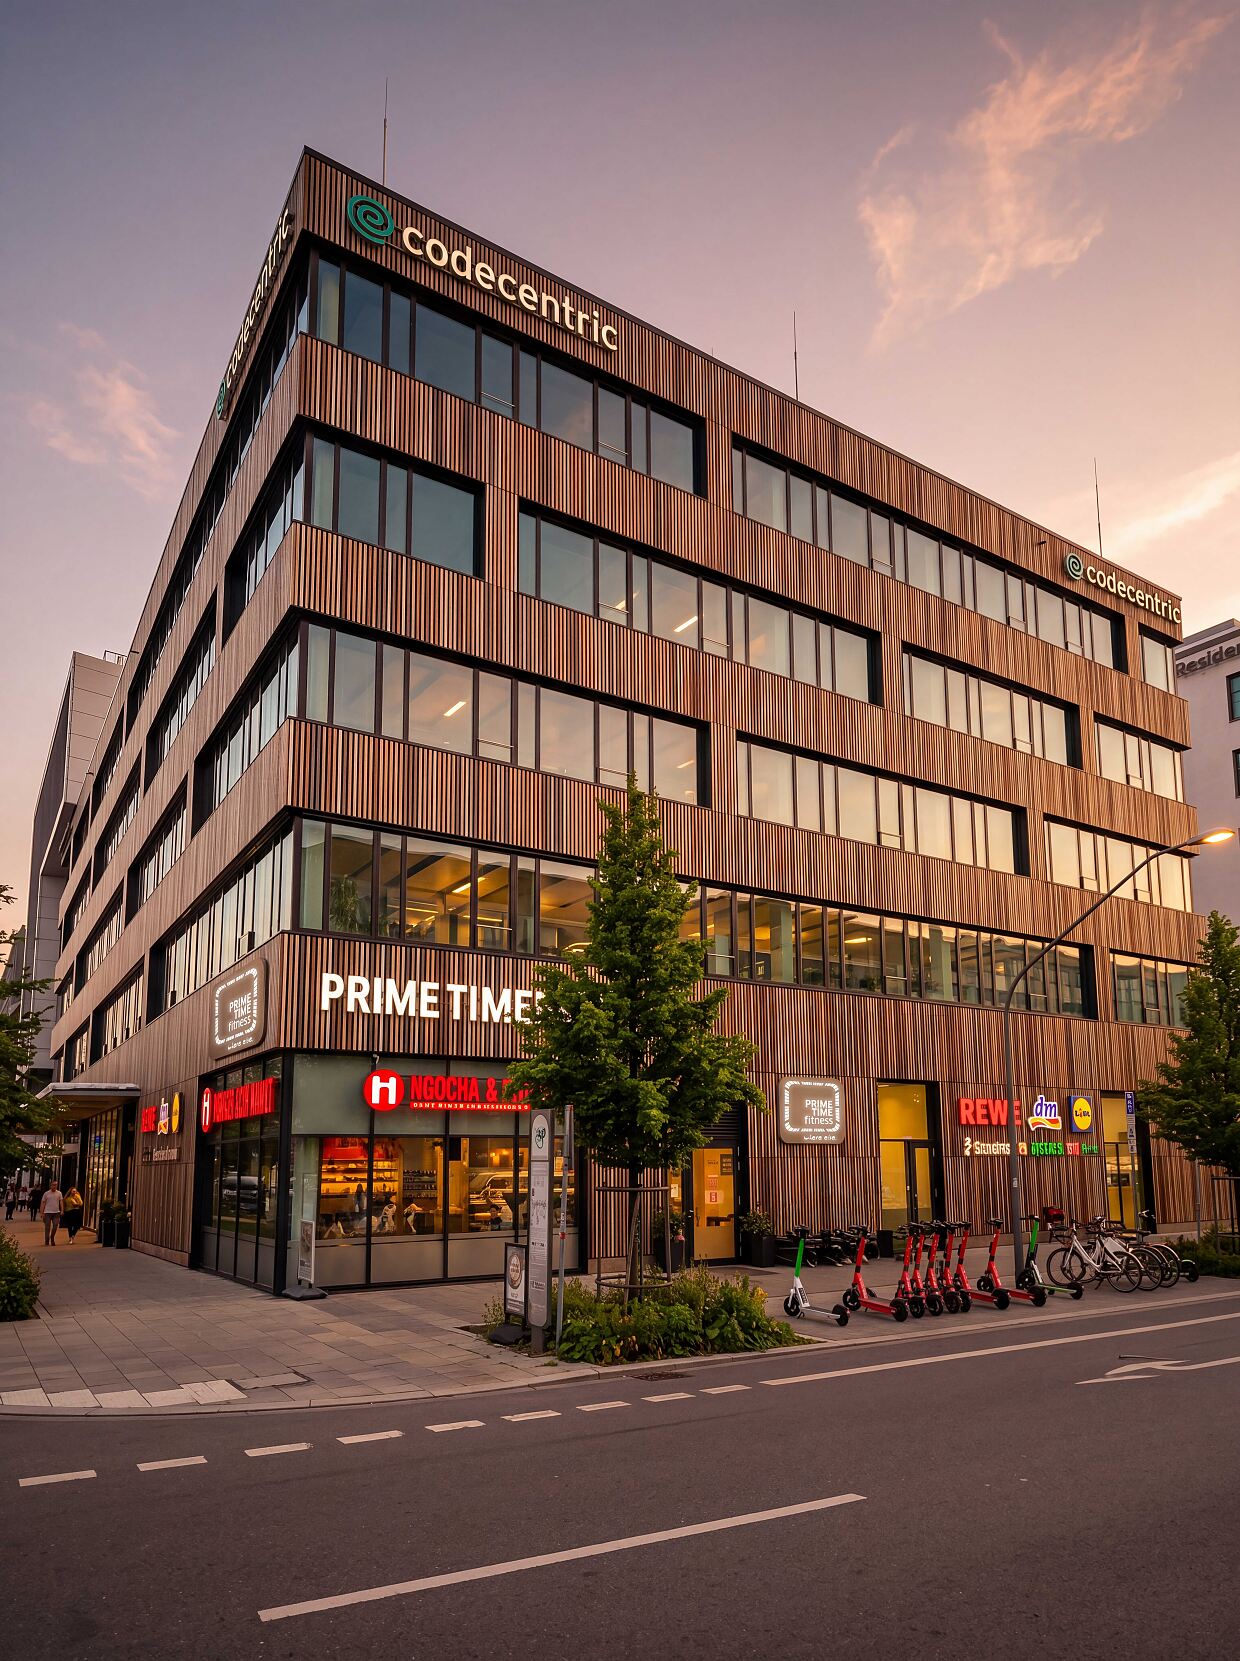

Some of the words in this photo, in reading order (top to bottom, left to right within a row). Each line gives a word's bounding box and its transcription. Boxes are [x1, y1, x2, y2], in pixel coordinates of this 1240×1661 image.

[226, 208, 290, 389] codecentric
[402, 226, 618, 351] codecentric
[1086, 565, 1182, 624] codecentric
[1175, 643, 1240, 678] Reside
[229, 992, 252, 1013] PRIME
[320, 972, 440, 1019] PRIME
[234, 1003, 252, 1020] TIME
[228, 1015, 251, 1032] fitness
[410, 1075, 480, 1102] NGOCHA
[485, 1077, 498, 1103] &
[805, 1099, 833, 1109] PRIME
[811, 1107, 834, 1117] TIME
[1034, 1096, 1057, 1118] dm
[804, 1115, 834, 1125] fitness
